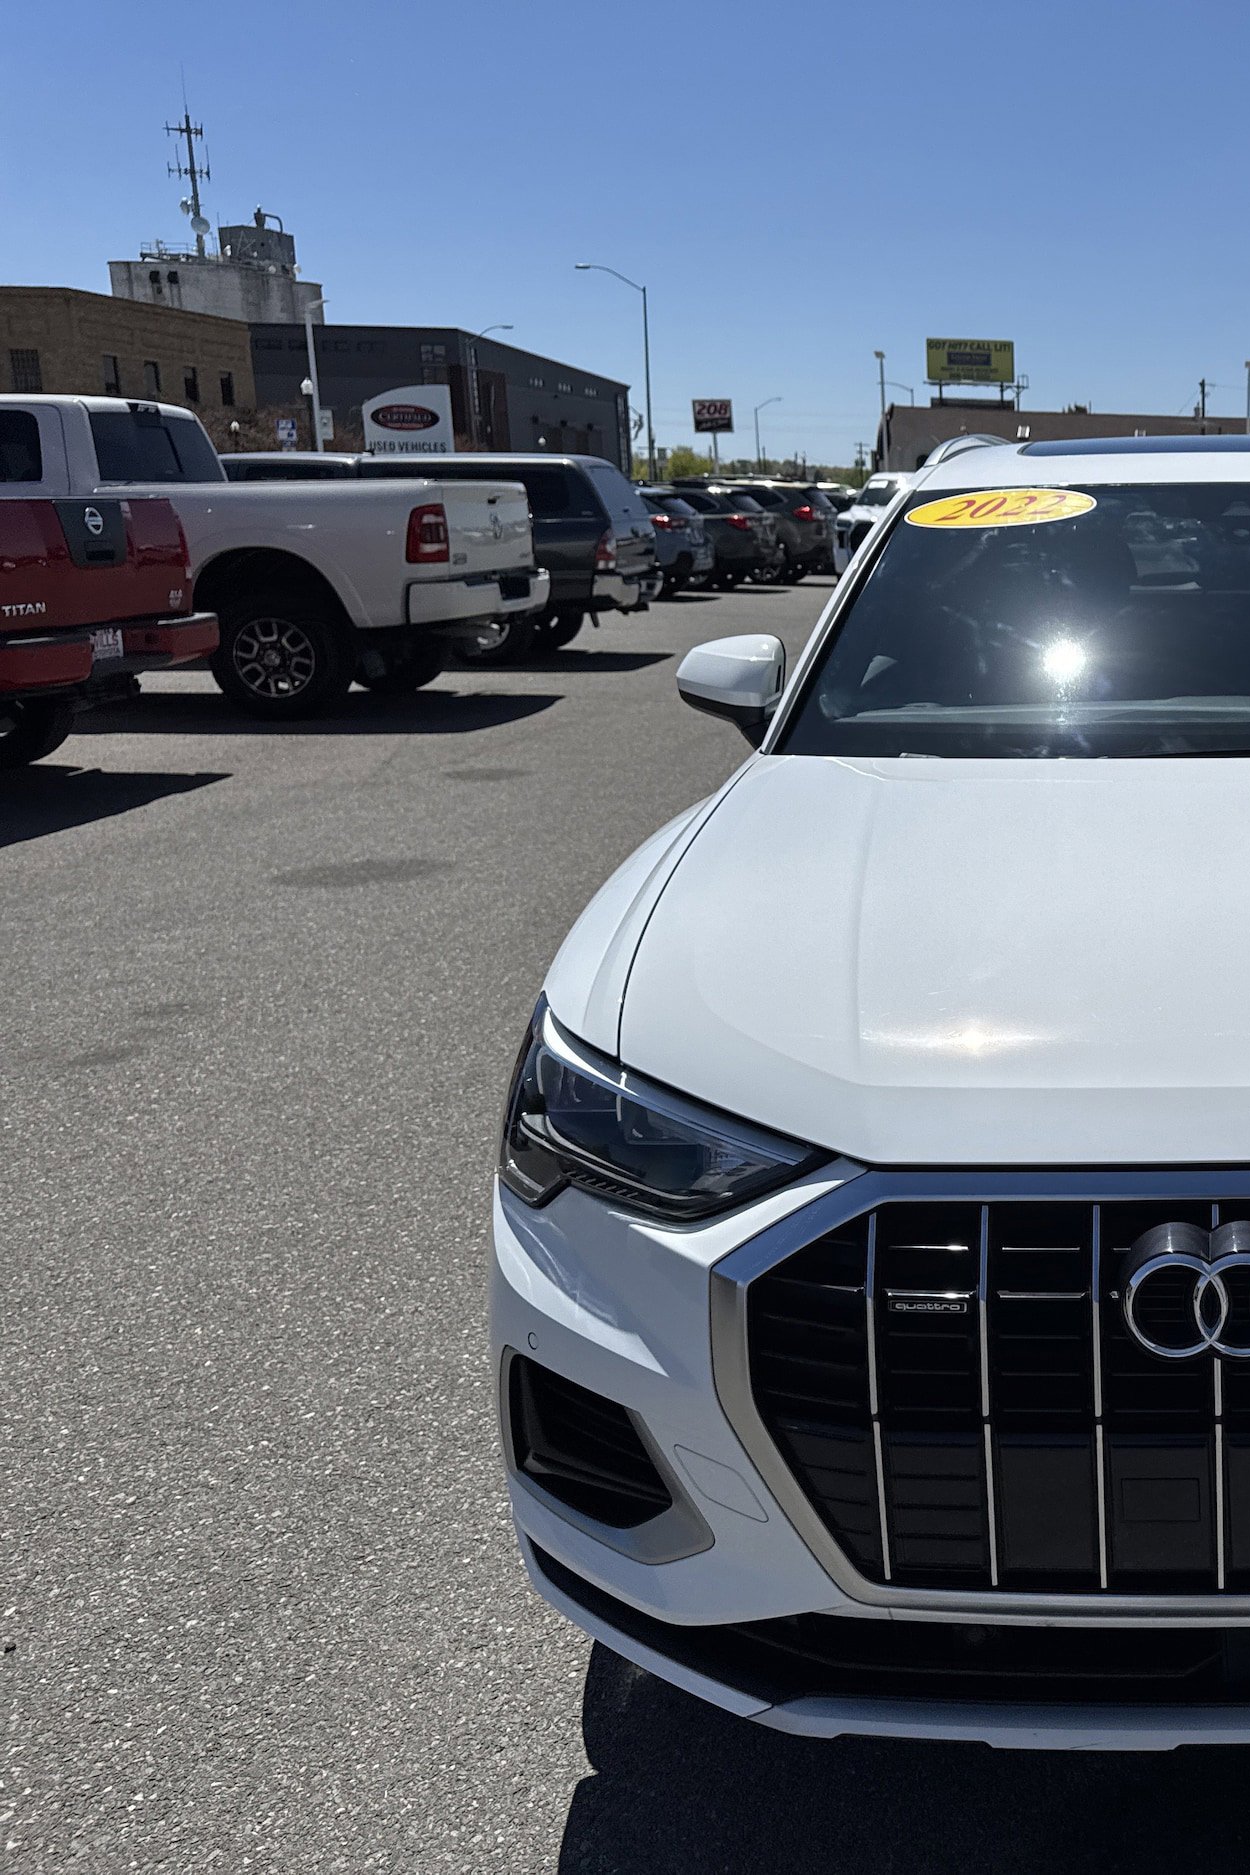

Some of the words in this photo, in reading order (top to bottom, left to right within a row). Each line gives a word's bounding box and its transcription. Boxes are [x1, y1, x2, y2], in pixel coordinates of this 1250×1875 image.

[696, 402, 728, 416] 208
[369, 440, 396, 452] USED
[399, 440, 447, 453] VEHICLES
[934, 494, 1067, 522] 2022
[1, 602, 46, 617] TITAN
[895, 1303, 961, 1311] quattro
